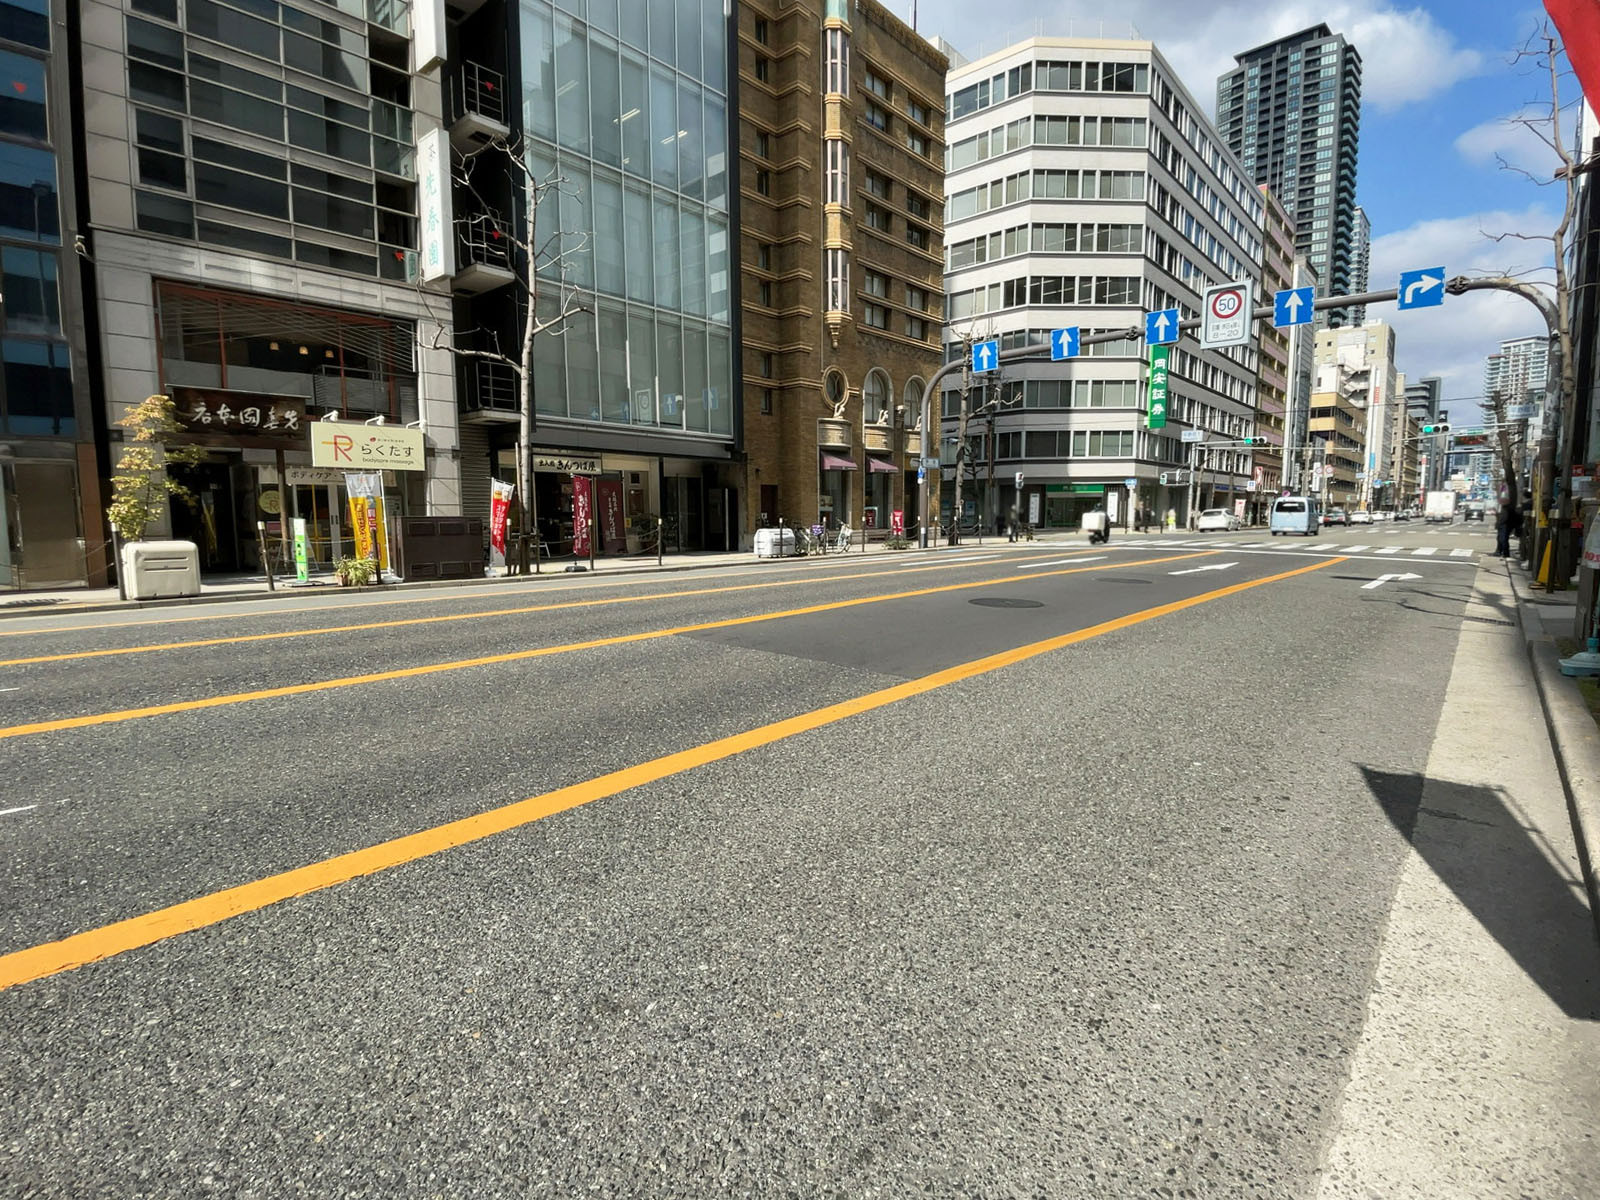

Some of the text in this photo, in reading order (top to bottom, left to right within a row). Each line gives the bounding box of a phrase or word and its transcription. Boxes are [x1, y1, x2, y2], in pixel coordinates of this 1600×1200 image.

[1218, 298, 1236, 312] 50
[1152, 358, 1167, 416] 岡安証券
[361, 443, 414, 458] らくたす
